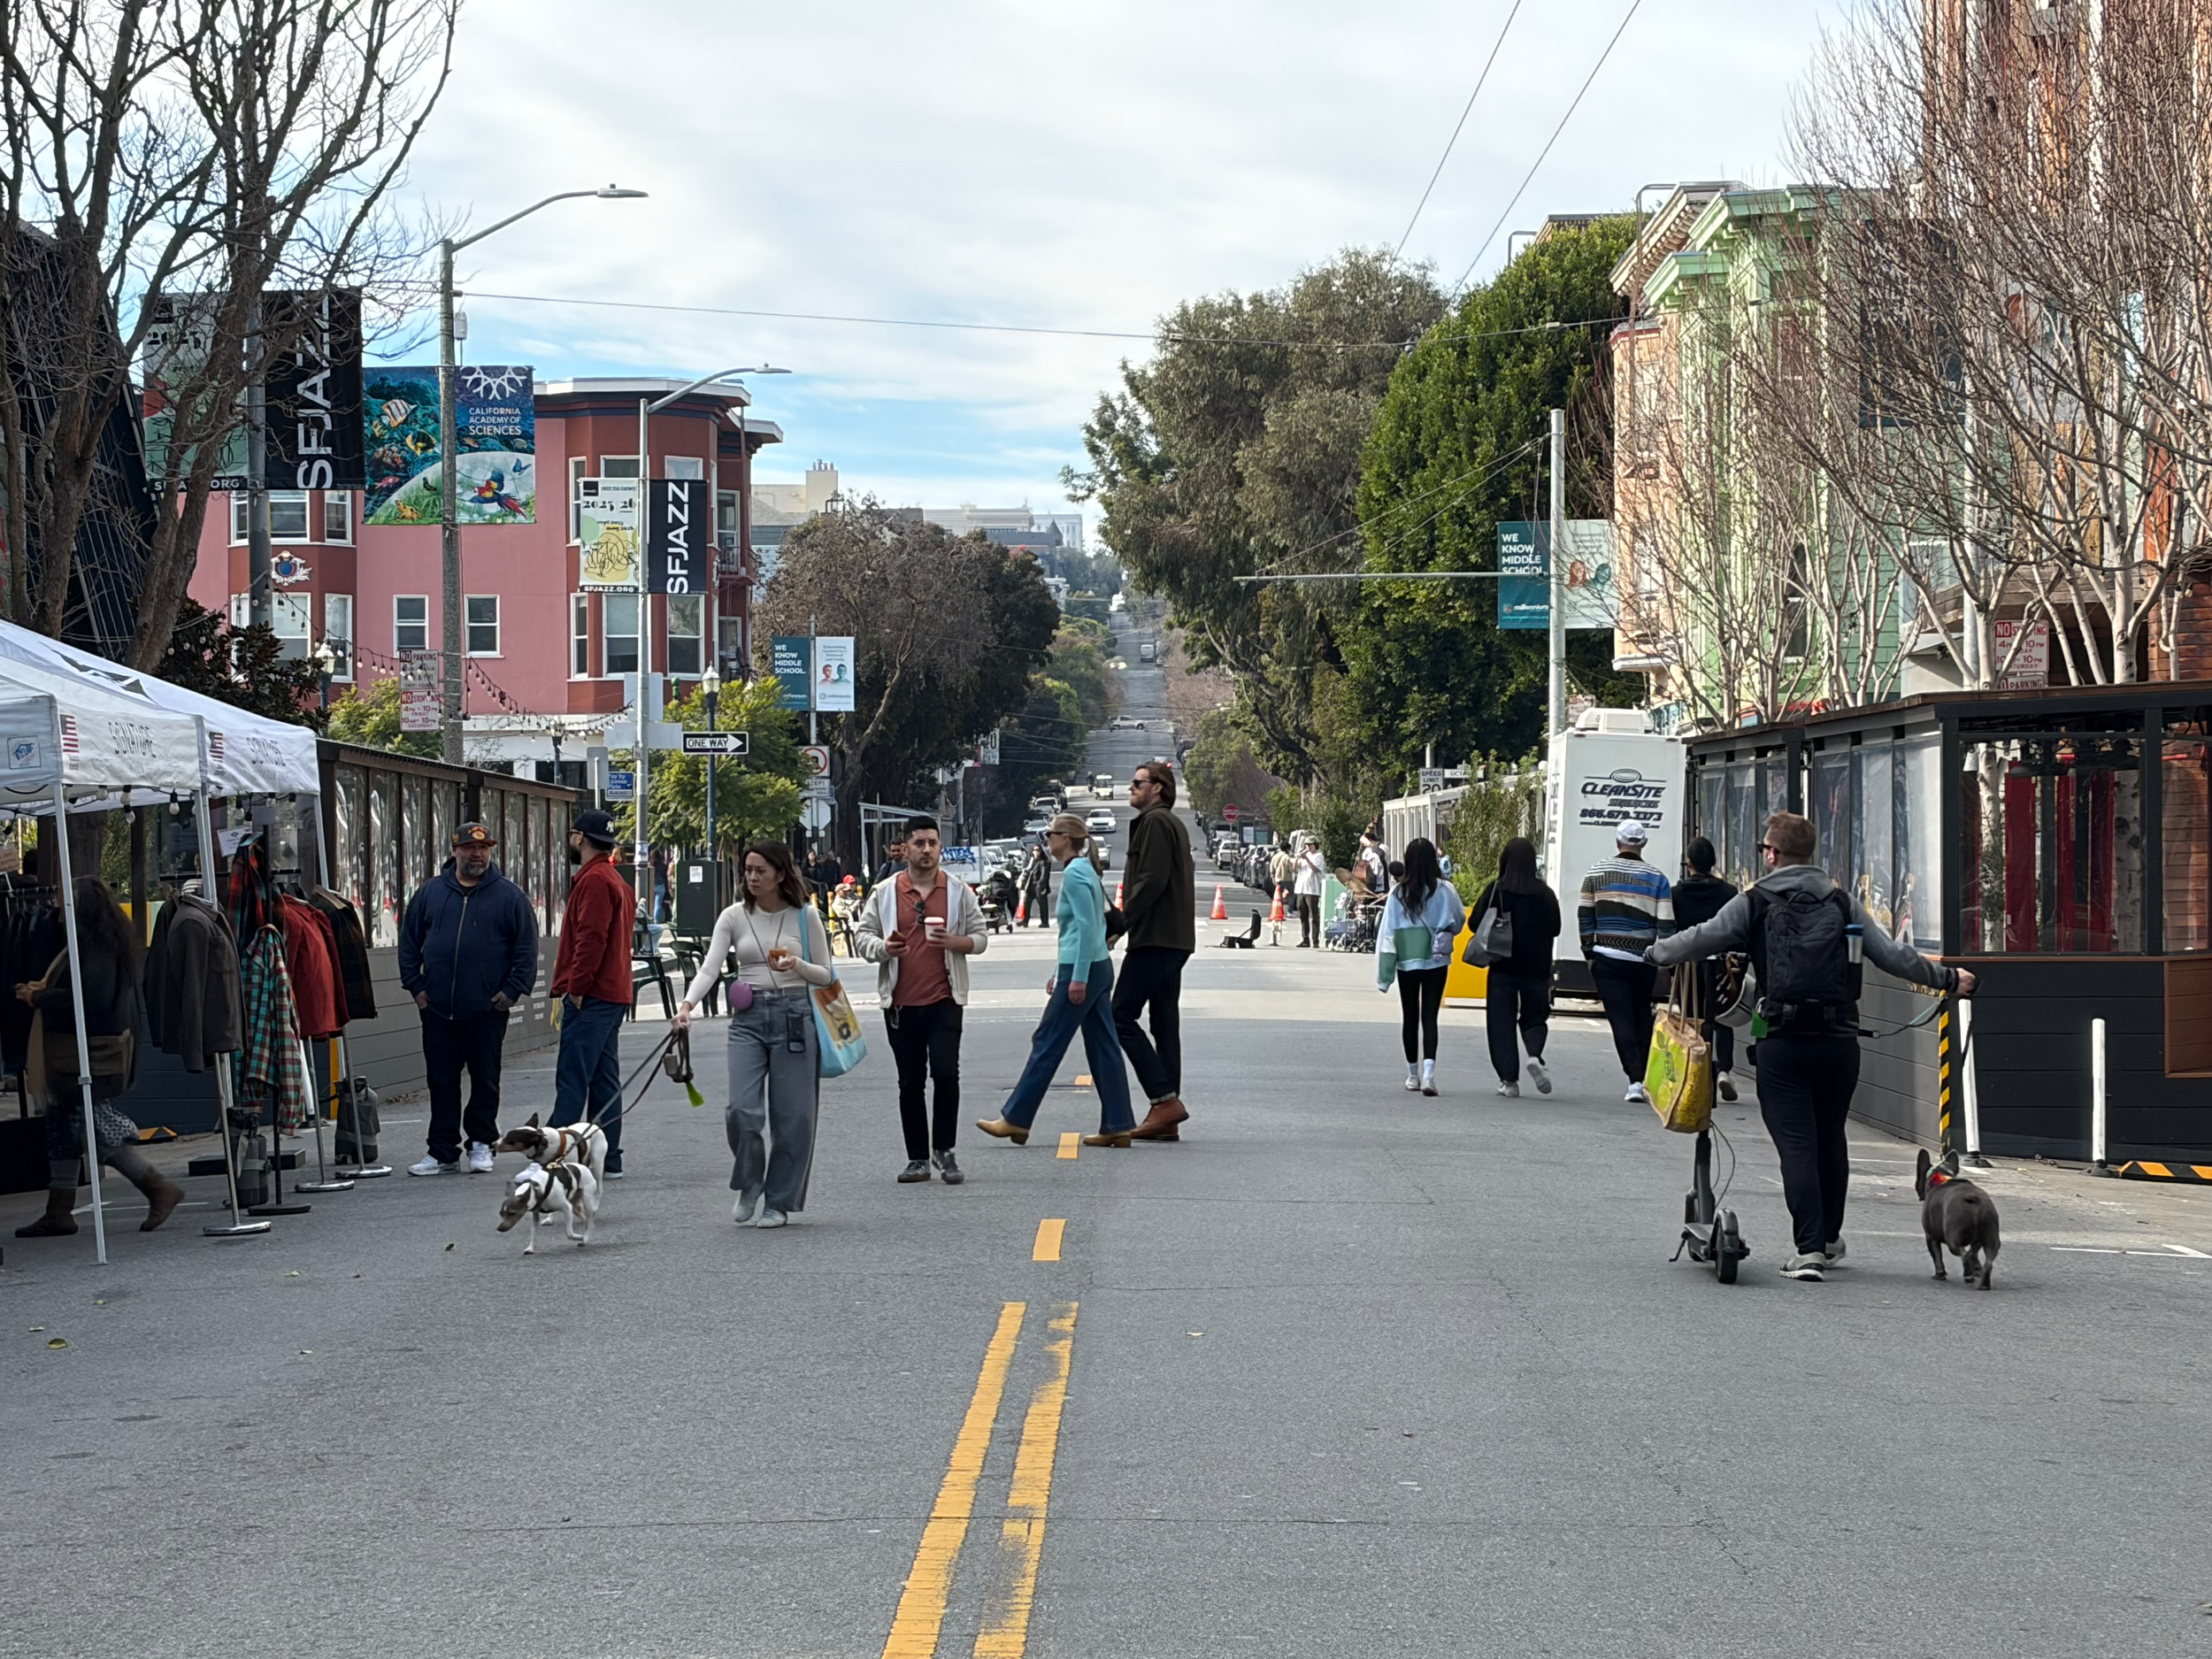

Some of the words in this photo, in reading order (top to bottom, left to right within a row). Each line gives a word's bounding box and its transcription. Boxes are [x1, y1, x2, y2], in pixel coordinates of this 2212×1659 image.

[469, 426, 522, 435] SCIENCES
[666, 481, 689, 594] SFJAZZ
[1501, 533, 1519, 542] WE
[1502, 544, 1535, 554] KNOW
[1502, 555, 1541, 565] MIDDLE
[1996, 622, 2011, 637] NO
[400, 650, 411, 662] NO
[2009, 679, 2043, 689] PARKING
[401, 692, 412, 703] NO
[687, 739, 707, 748] ONE
[710, 738, 728, 748] WAY
[1422, 783, 1441, 795] 20
